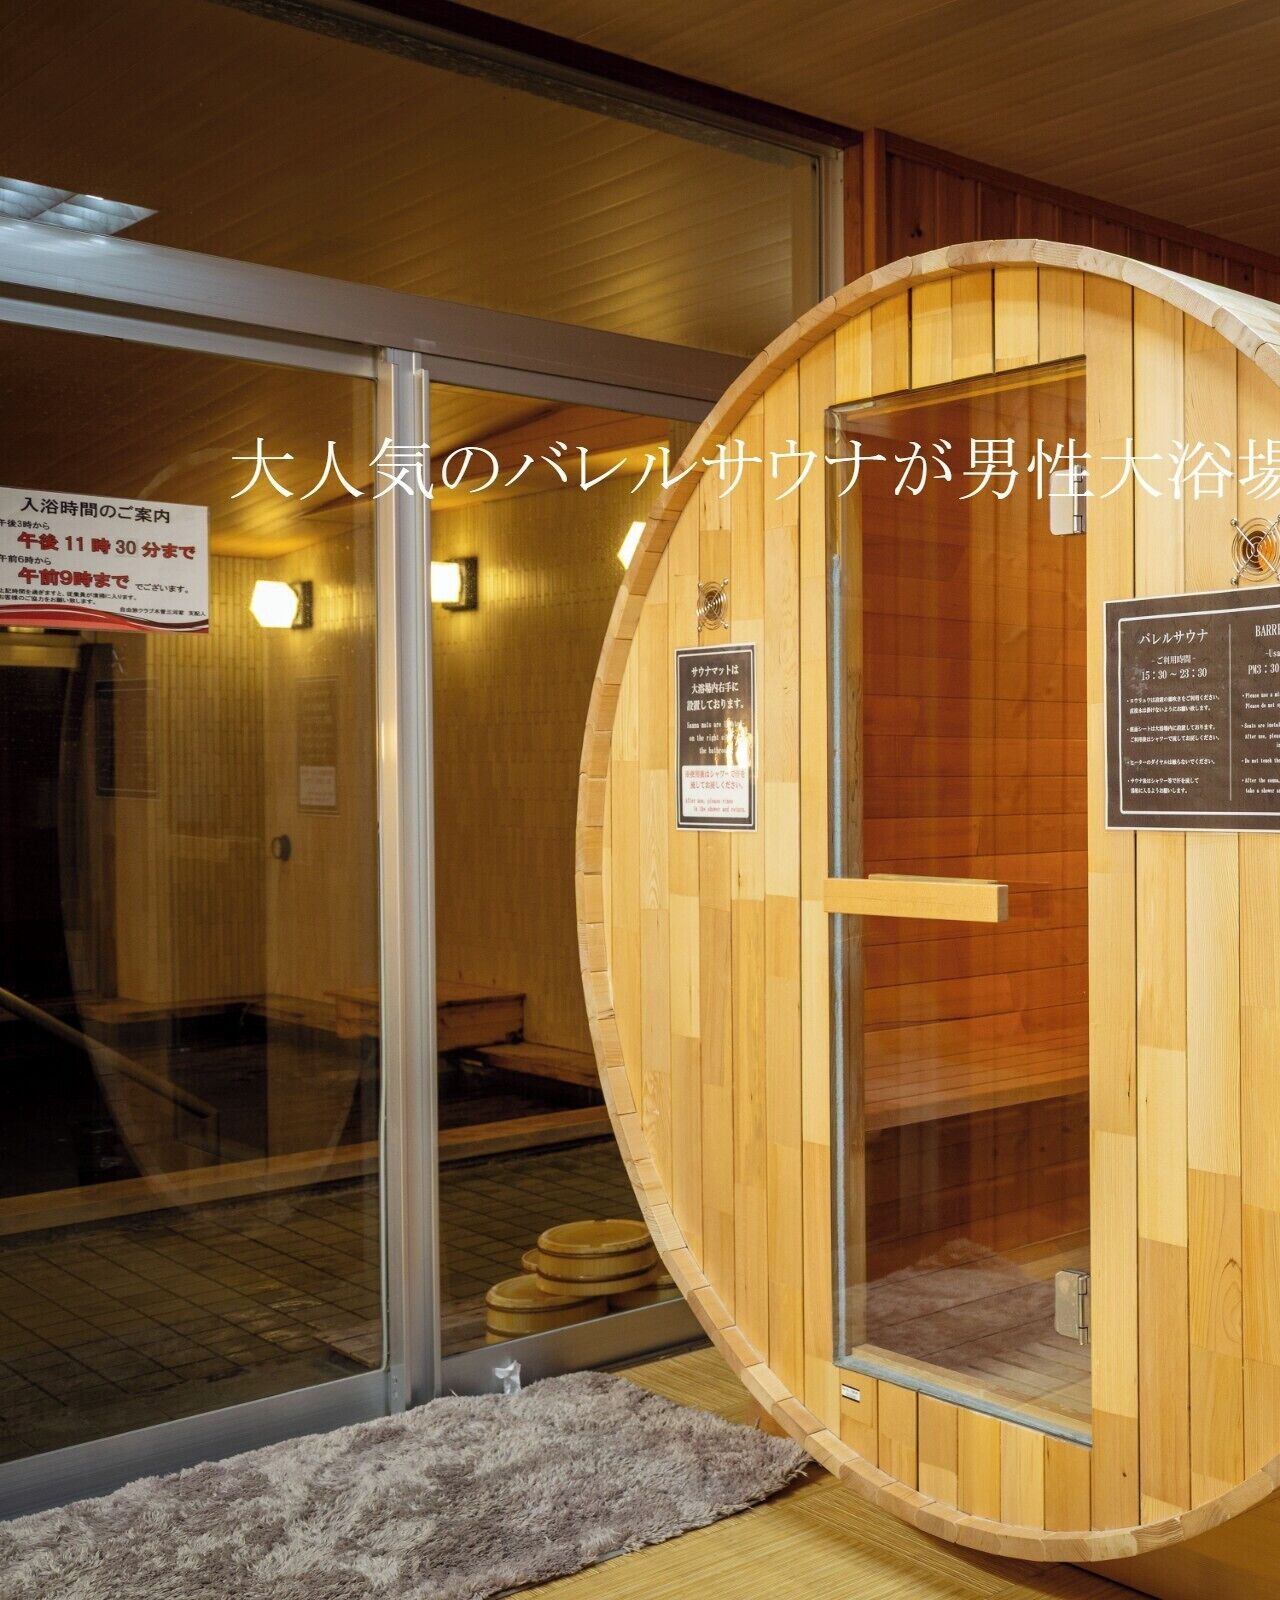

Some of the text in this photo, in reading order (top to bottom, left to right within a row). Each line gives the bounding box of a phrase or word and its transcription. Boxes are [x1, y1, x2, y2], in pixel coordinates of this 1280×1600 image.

[20, 497, 170, 523] 入浴時間のご案内
[18, 567, 130, 590] 午前9時まで
[691, 664, 739, 678] サウナマットは
[691, 682, 739, 695] 大浴場内右手に
